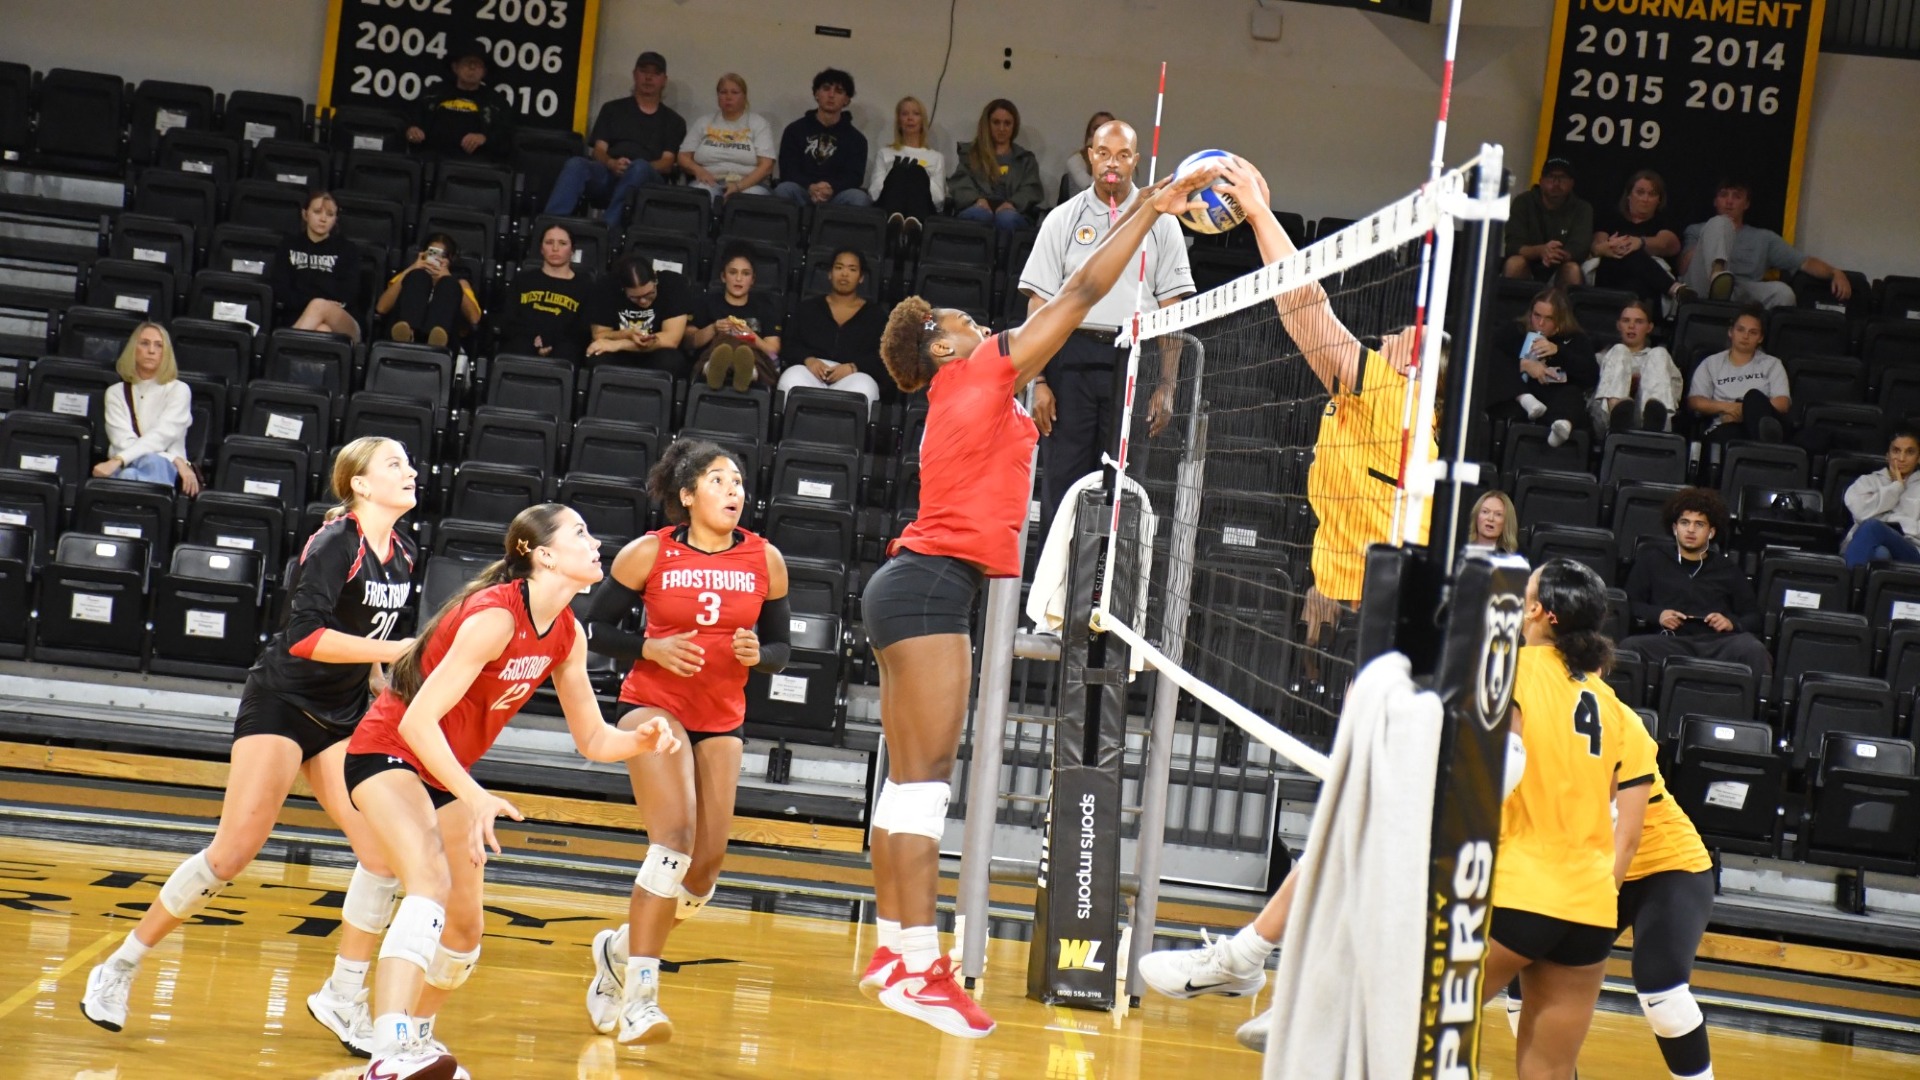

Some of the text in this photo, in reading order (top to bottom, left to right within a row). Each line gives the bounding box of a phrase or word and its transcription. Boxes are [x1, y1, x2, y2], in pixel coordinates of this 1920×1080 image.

[476, 0, 568, 29] 2003
[1578, 0, 1801, 29] URNAMENT
[355, 21, 448, 60] 2004
[1576, 24, 1785, 71] 2011 2014
[1570, 69, 1780, 115] 2015 2016
[1565, 113, 1661, 149] 2019
[520, 290, 580, 313] WEST LIBERTY
[661, 568, 756, 593] FROSTBURG
[365, 611, 399, 641] 20
[695, 591, 722, 626] 3
[490, 682, 531, 711] 12
[1574, 690, 1603, 757] 4
[1076, 793, 1096, 920] sports imports
[1058, 938, 1106, 972] WL
[1423, 892, 1449, 1080] IVERSITY
